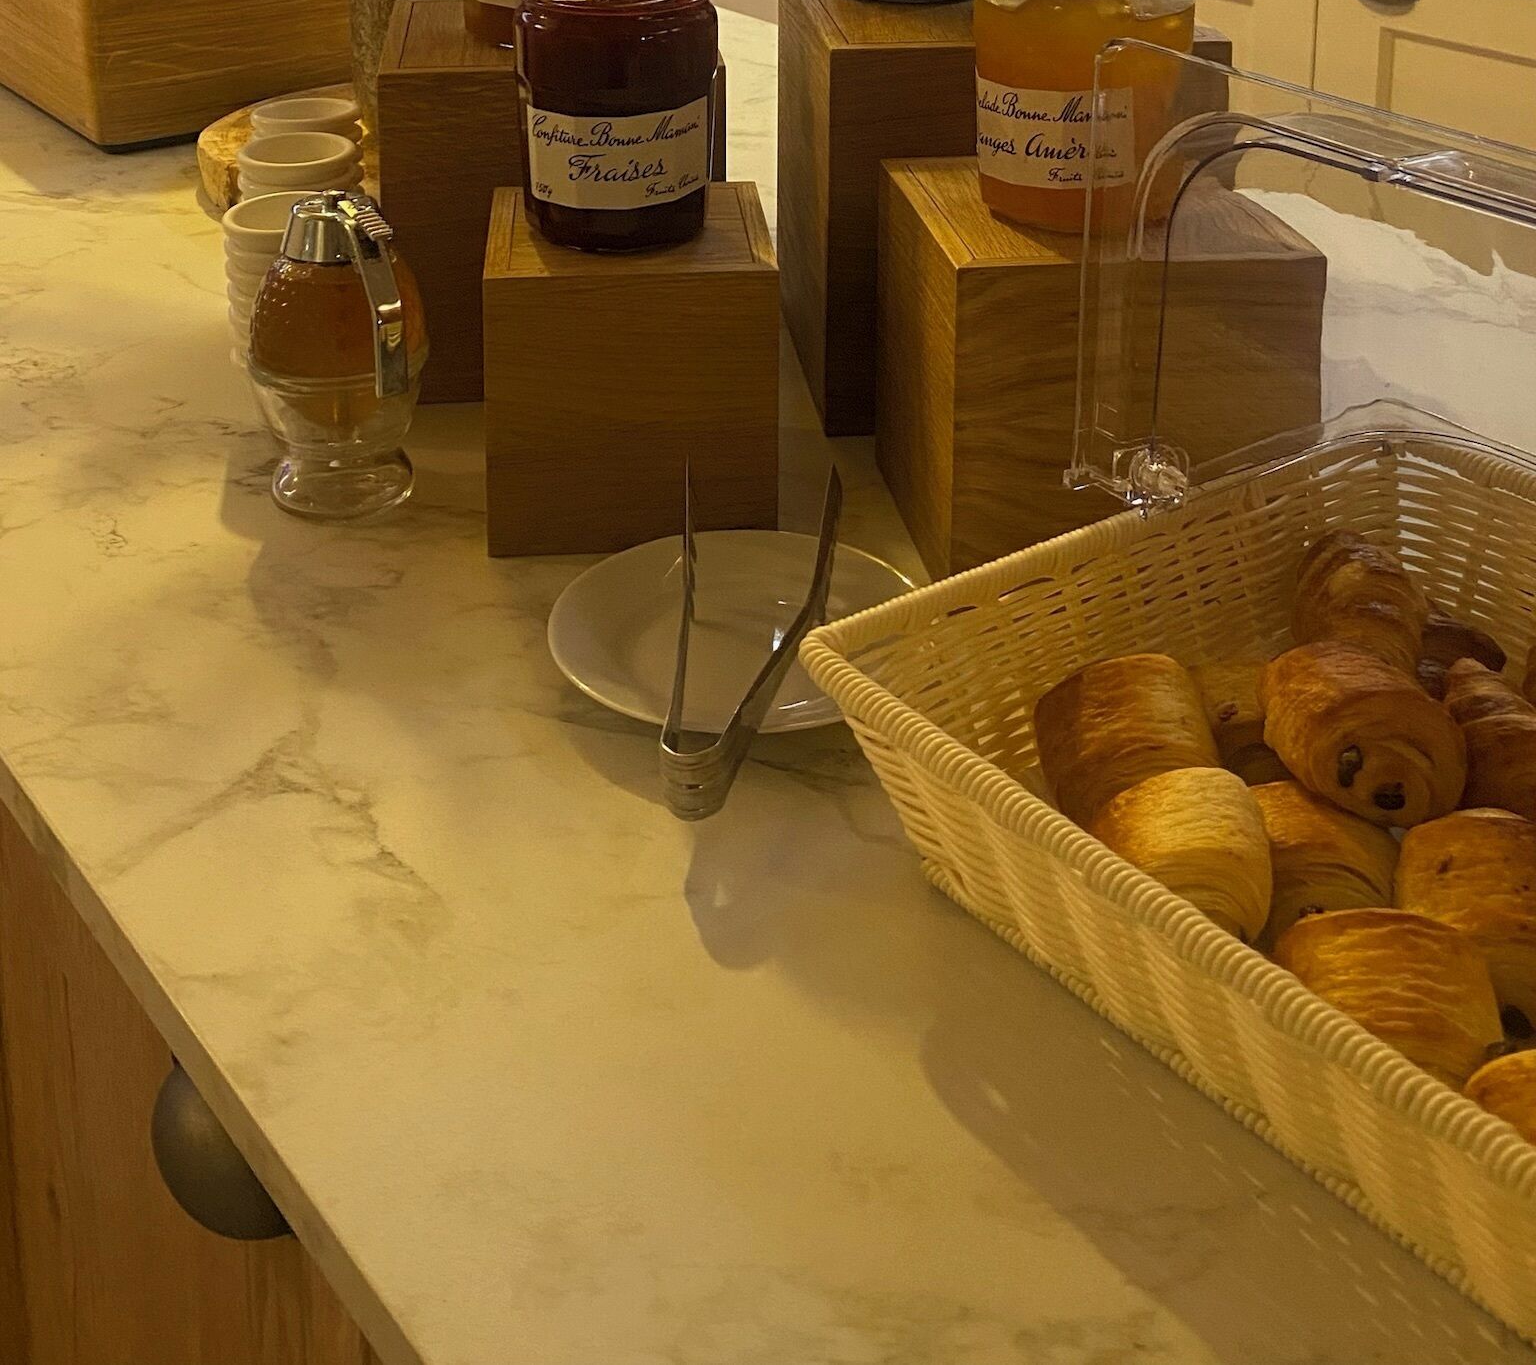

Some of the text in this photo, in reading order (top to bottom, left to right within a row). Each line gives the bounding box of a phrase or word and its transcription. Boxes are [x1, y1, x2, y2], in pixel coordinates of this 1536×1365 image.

[1002, 92, 1051, 121] Bonne
[532, 114, 700, 147] Confiture Bonne Maman
[568, 153, 668, 182] Fraises
